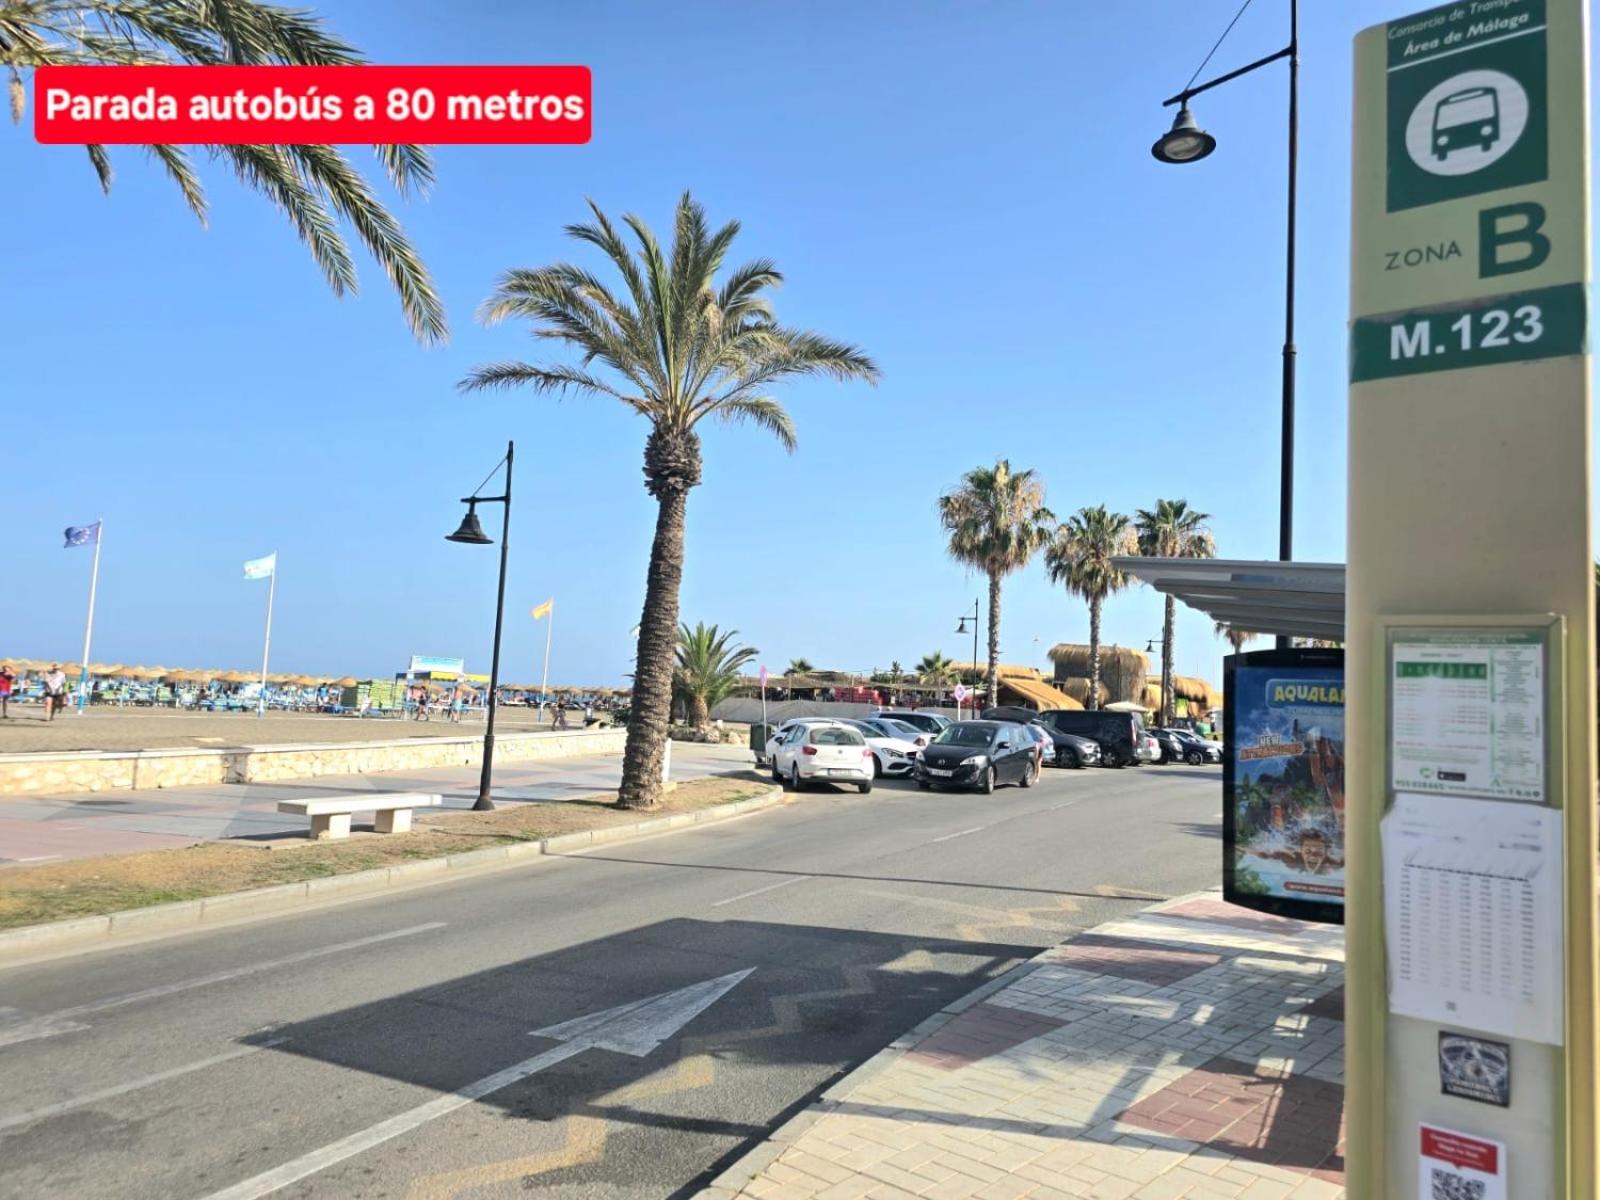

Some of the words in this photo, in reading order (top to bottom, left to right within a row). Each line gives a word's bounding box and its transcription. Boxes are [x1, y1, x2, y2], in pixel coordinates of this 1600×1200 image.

[1388, 15, 1446, 40] Consorcio
[1449, 8, 1465, 22] de
[1404, 39, 1440, 57] Área
[1443, 31, 1463, 45] de
[1466, 13, 1529, 39] Málaga
[1385, 241, 1462, 271] ZONA
[1478, 201, 1551, 280] B
[1390, 305, 1544, 360] M.123
